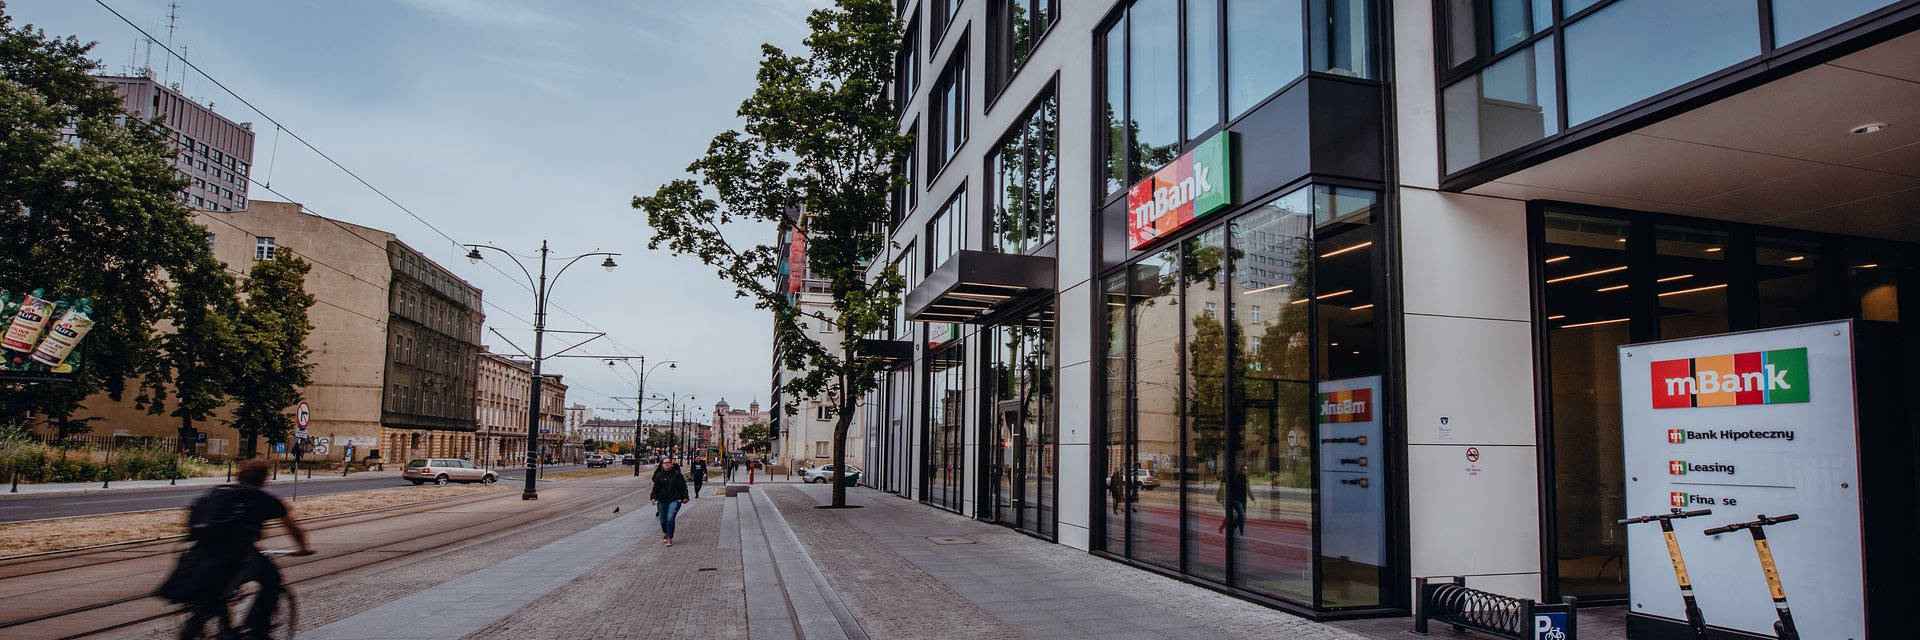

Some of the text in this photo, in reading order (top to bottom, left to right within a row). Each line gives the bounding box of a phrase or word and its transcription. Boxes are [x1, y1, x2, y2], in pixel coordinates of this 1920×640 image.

[1135, 162, 1211, 229] mBank
[1665, 364, 1791, 396] mBank
[1720, 429, 1795, 442] Hipoteczny
[1688, 462, 1735, 475] Leasing
[1534, 615, 1552, 640] P
